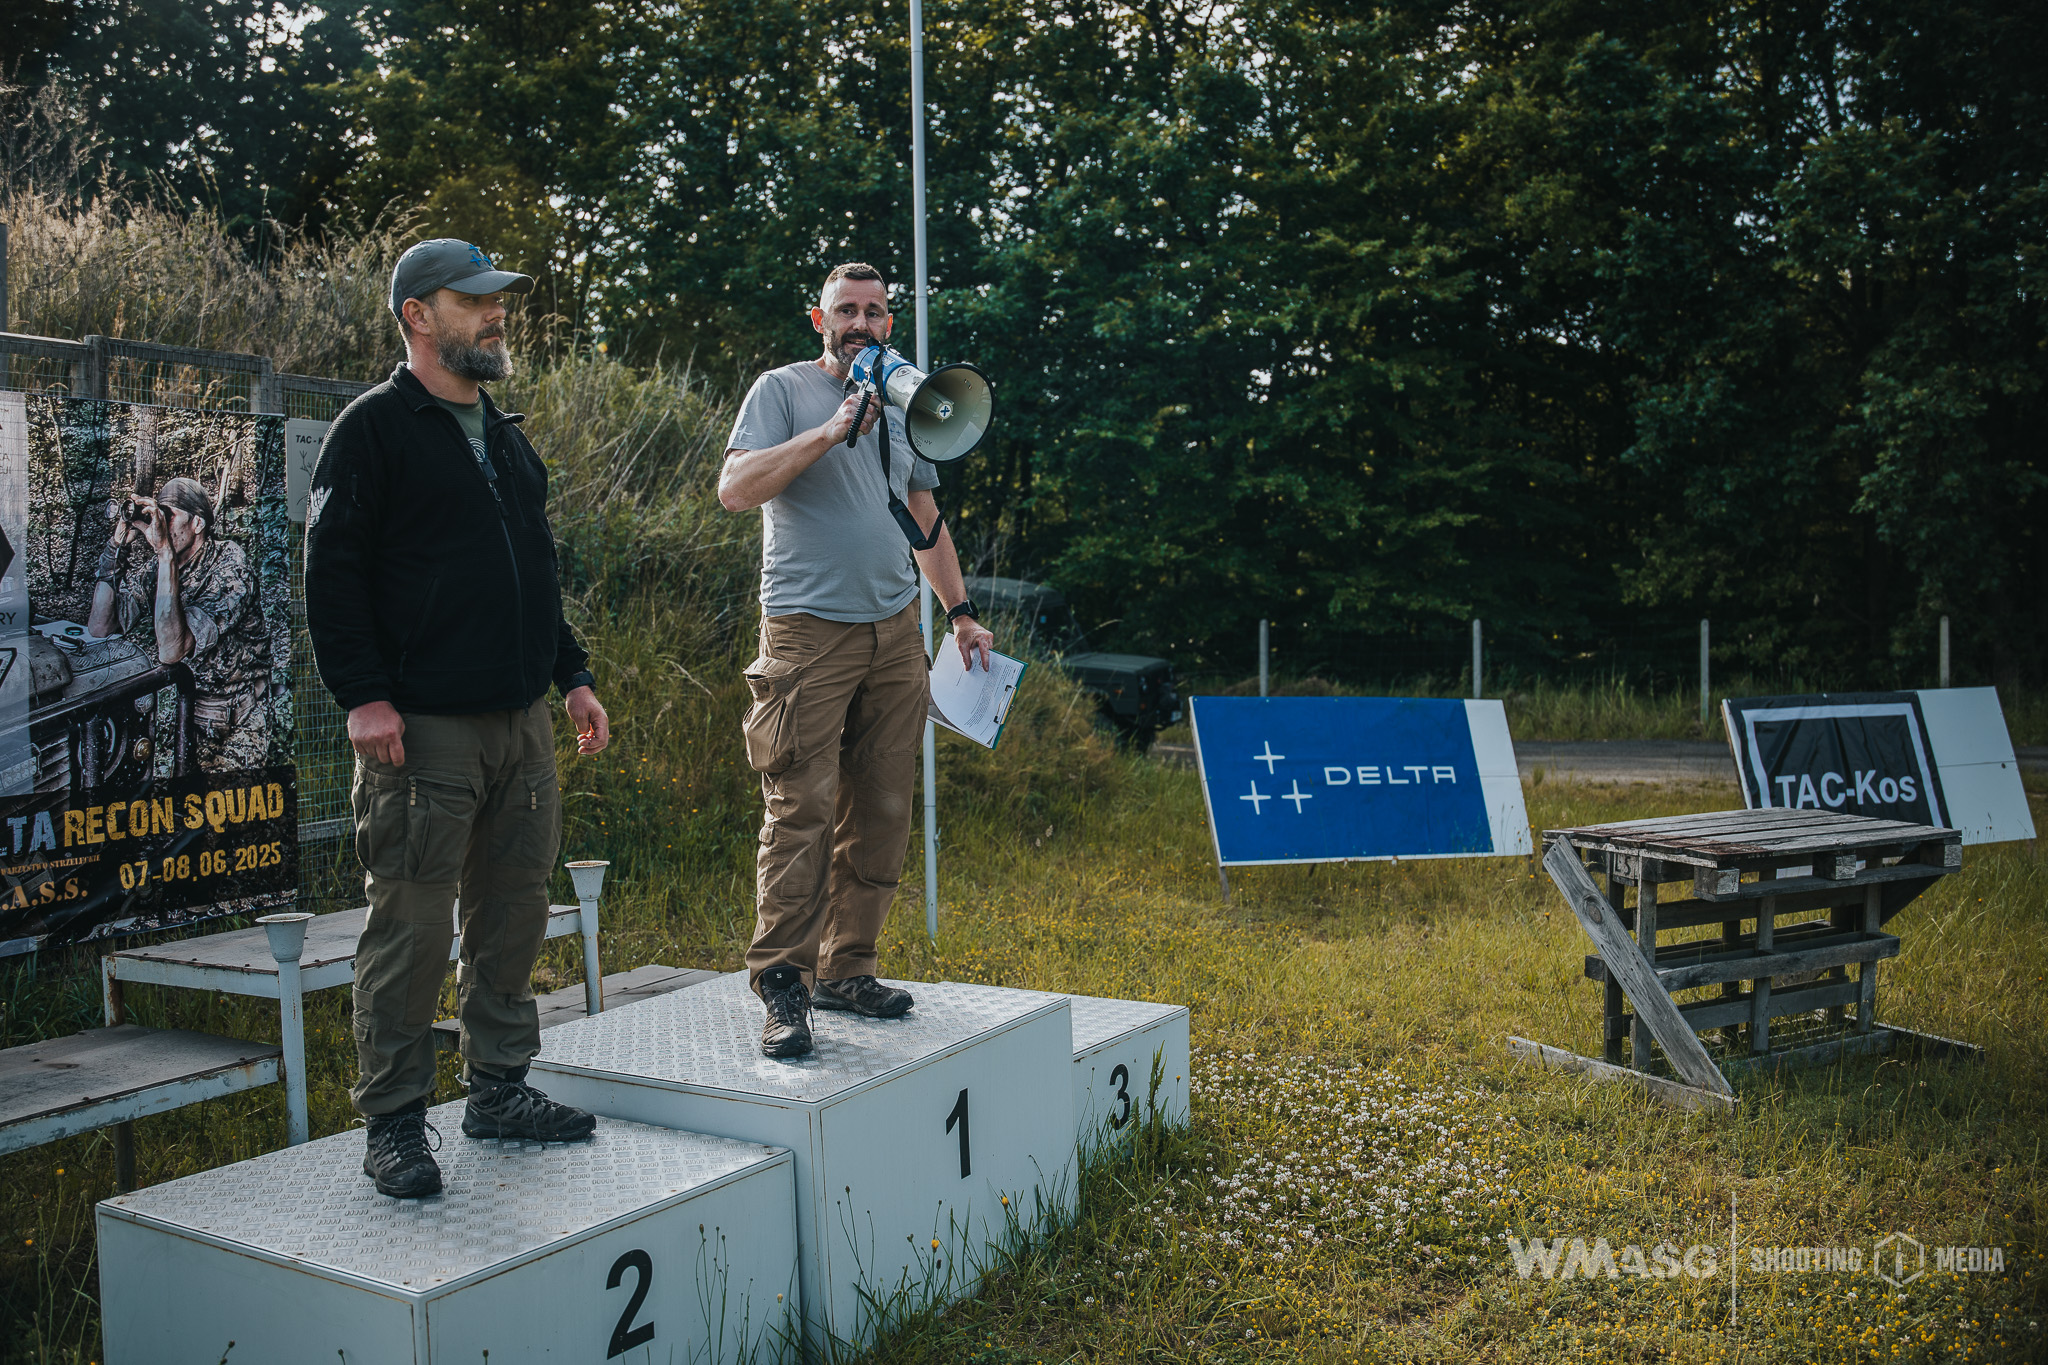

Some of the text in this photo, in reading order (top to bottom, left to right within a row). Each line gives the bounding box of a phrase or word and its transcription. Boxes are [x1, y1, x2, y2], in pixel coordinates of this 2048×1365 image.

[296, 435, 312, 444] TAC
[1324, 765, 1457, 785] DELTA
[1775, 769, 1917, 809] TAC-Kos
[0, 782, 284, 857] TA RECON SQUAD
[0, 877, 88, 911] .A.S.S.
[1109, 1063, 1130, 1130] 3
[945, 1088, 972, 1180] 1
[605, 1248, 656, 1360] 2
